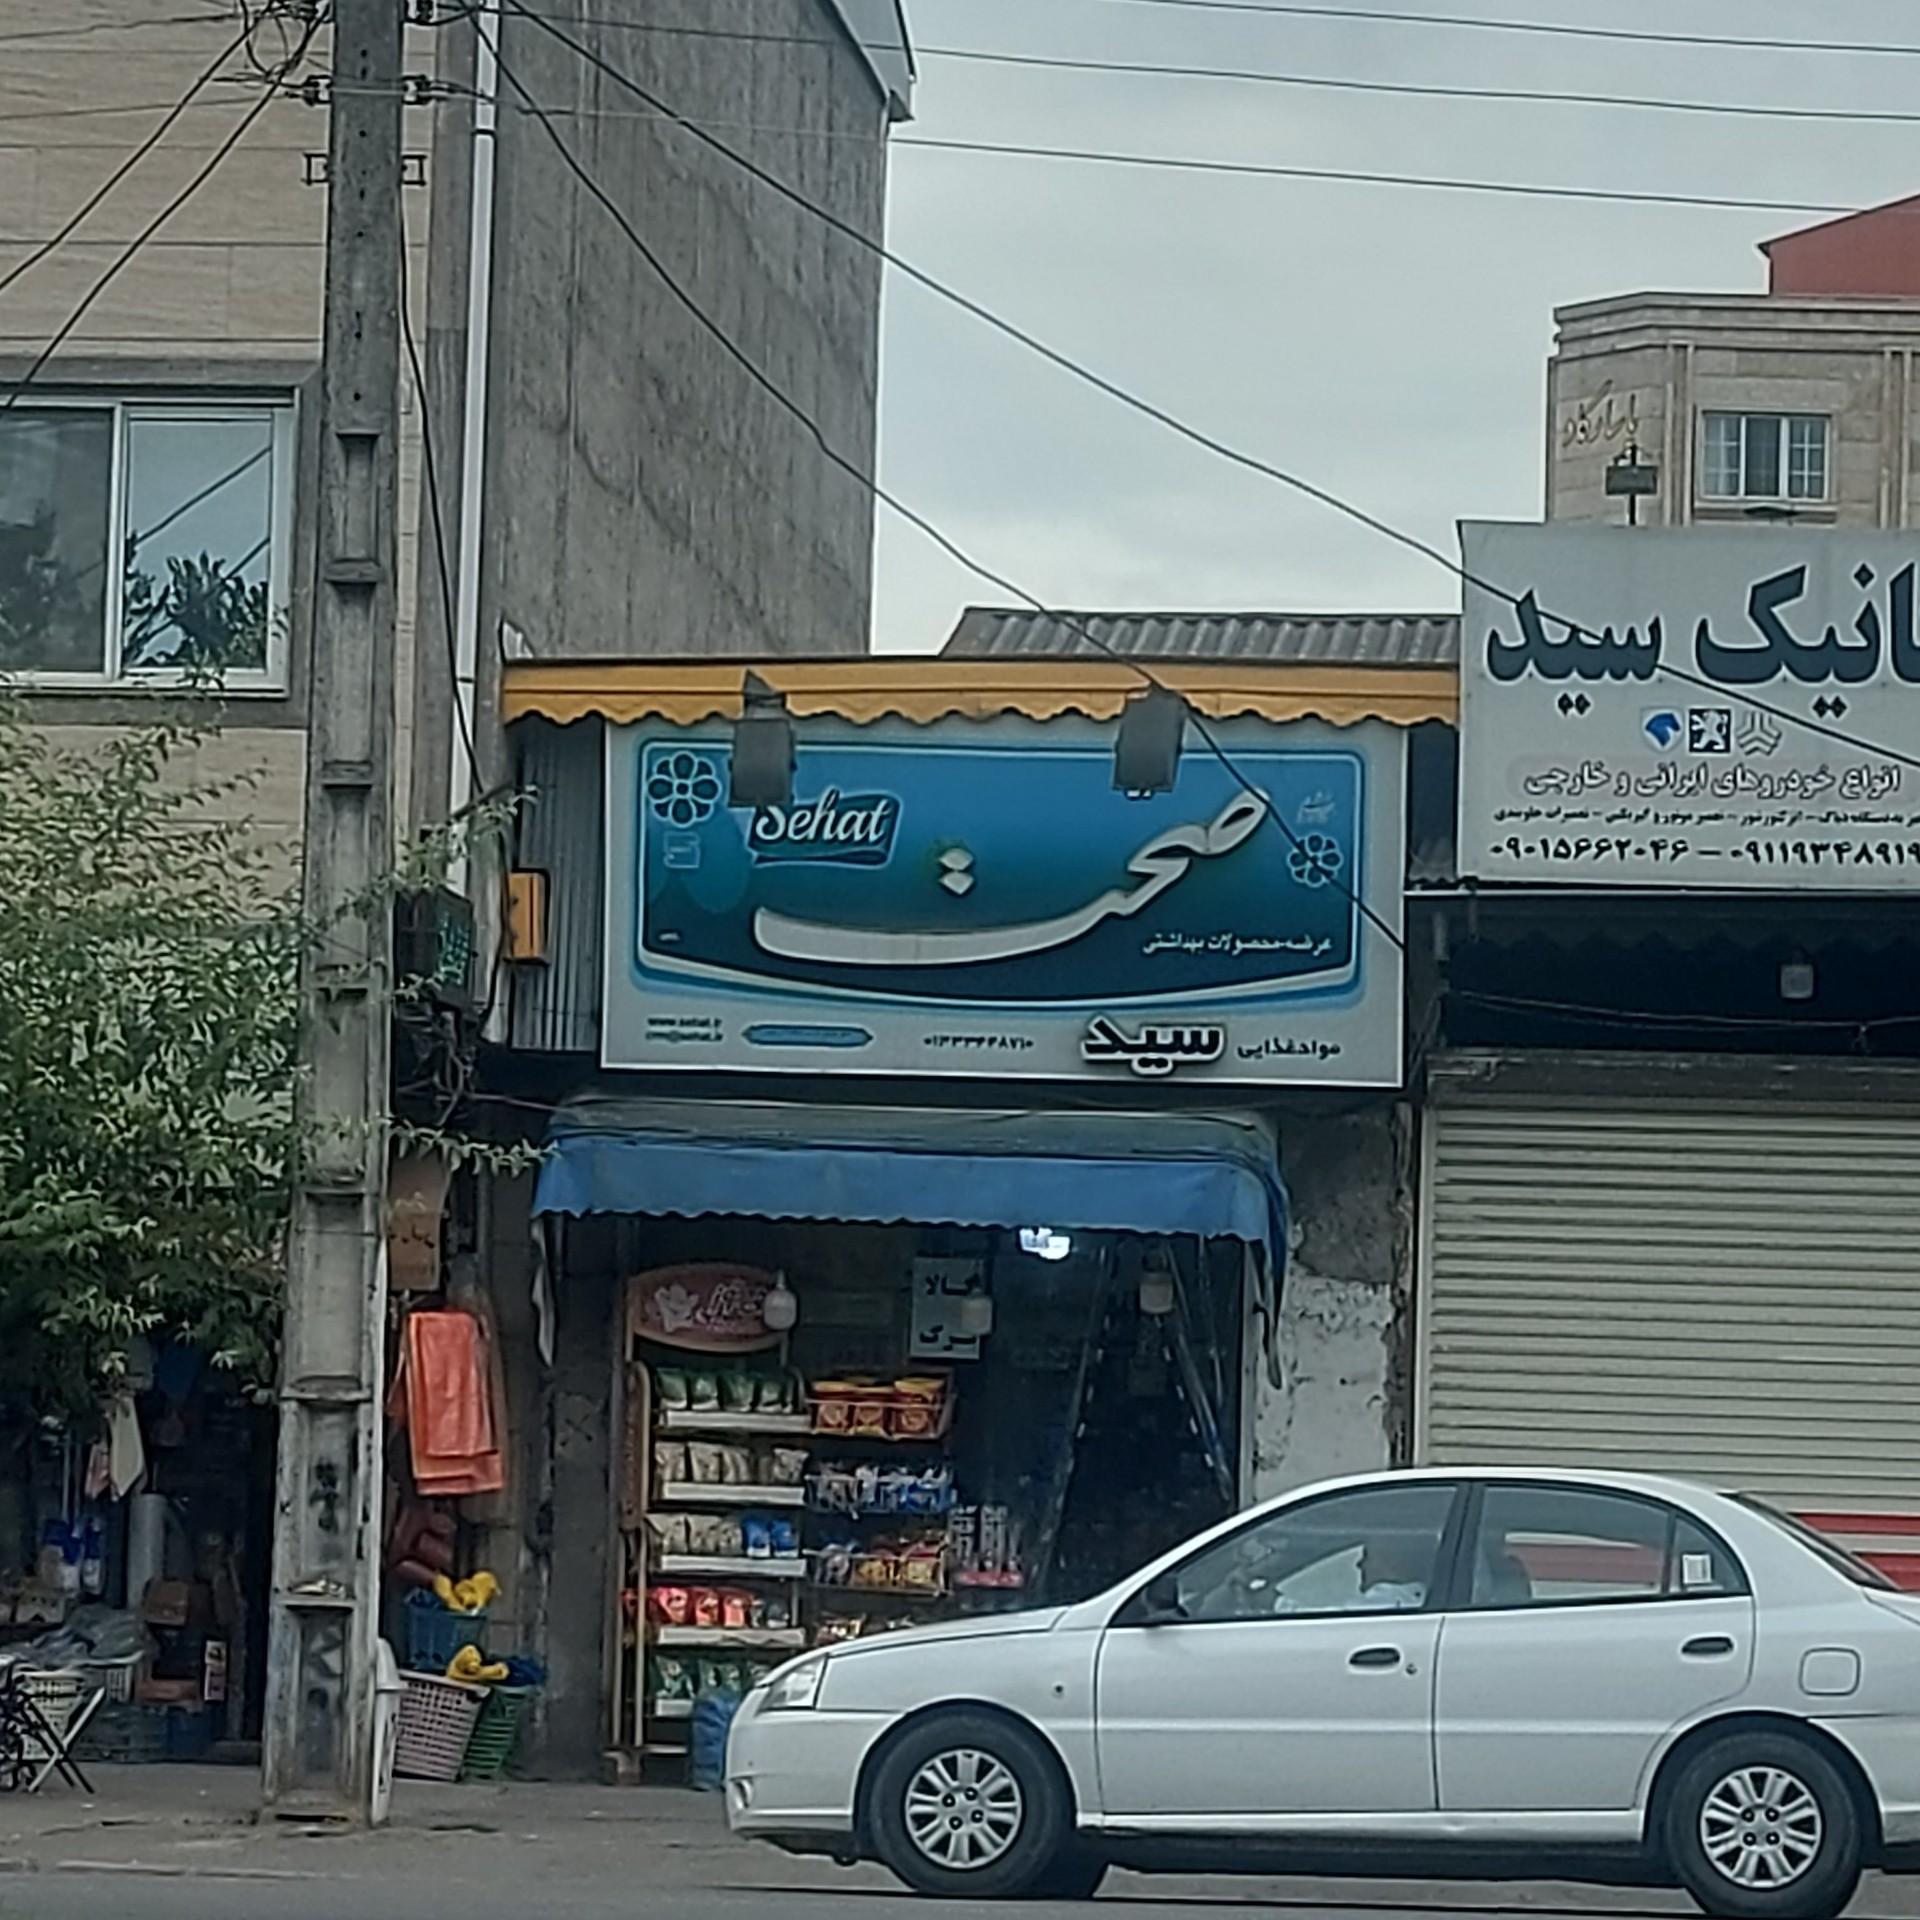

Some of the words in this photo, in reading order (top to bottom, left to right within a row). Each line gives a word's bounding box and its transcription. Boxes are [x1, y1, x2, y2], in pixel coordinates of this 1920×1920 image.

[1487, 590, 1661, 716] سید
[1695, 563, 1920, 718] انیک
[1524, 761, 1610, 796] خارجی
[1614, 771, 1631, 796] و
[1634, 762, 1708, 797] ایرانی
[1711, 764, 1835, 799] خودروهای
[1839, 765, 1900, 799] انواع
[1490, 836, 1689, 864] ۰۹۰۱۵۶۶۲۰۴۶
[754, 787, 1272, 966] صحت
[1143, 932, 1205, 954] بهداشتی
[1208, 932, 1284, 956] محصولات
[1083, 1014, 1224, 1074] سید
